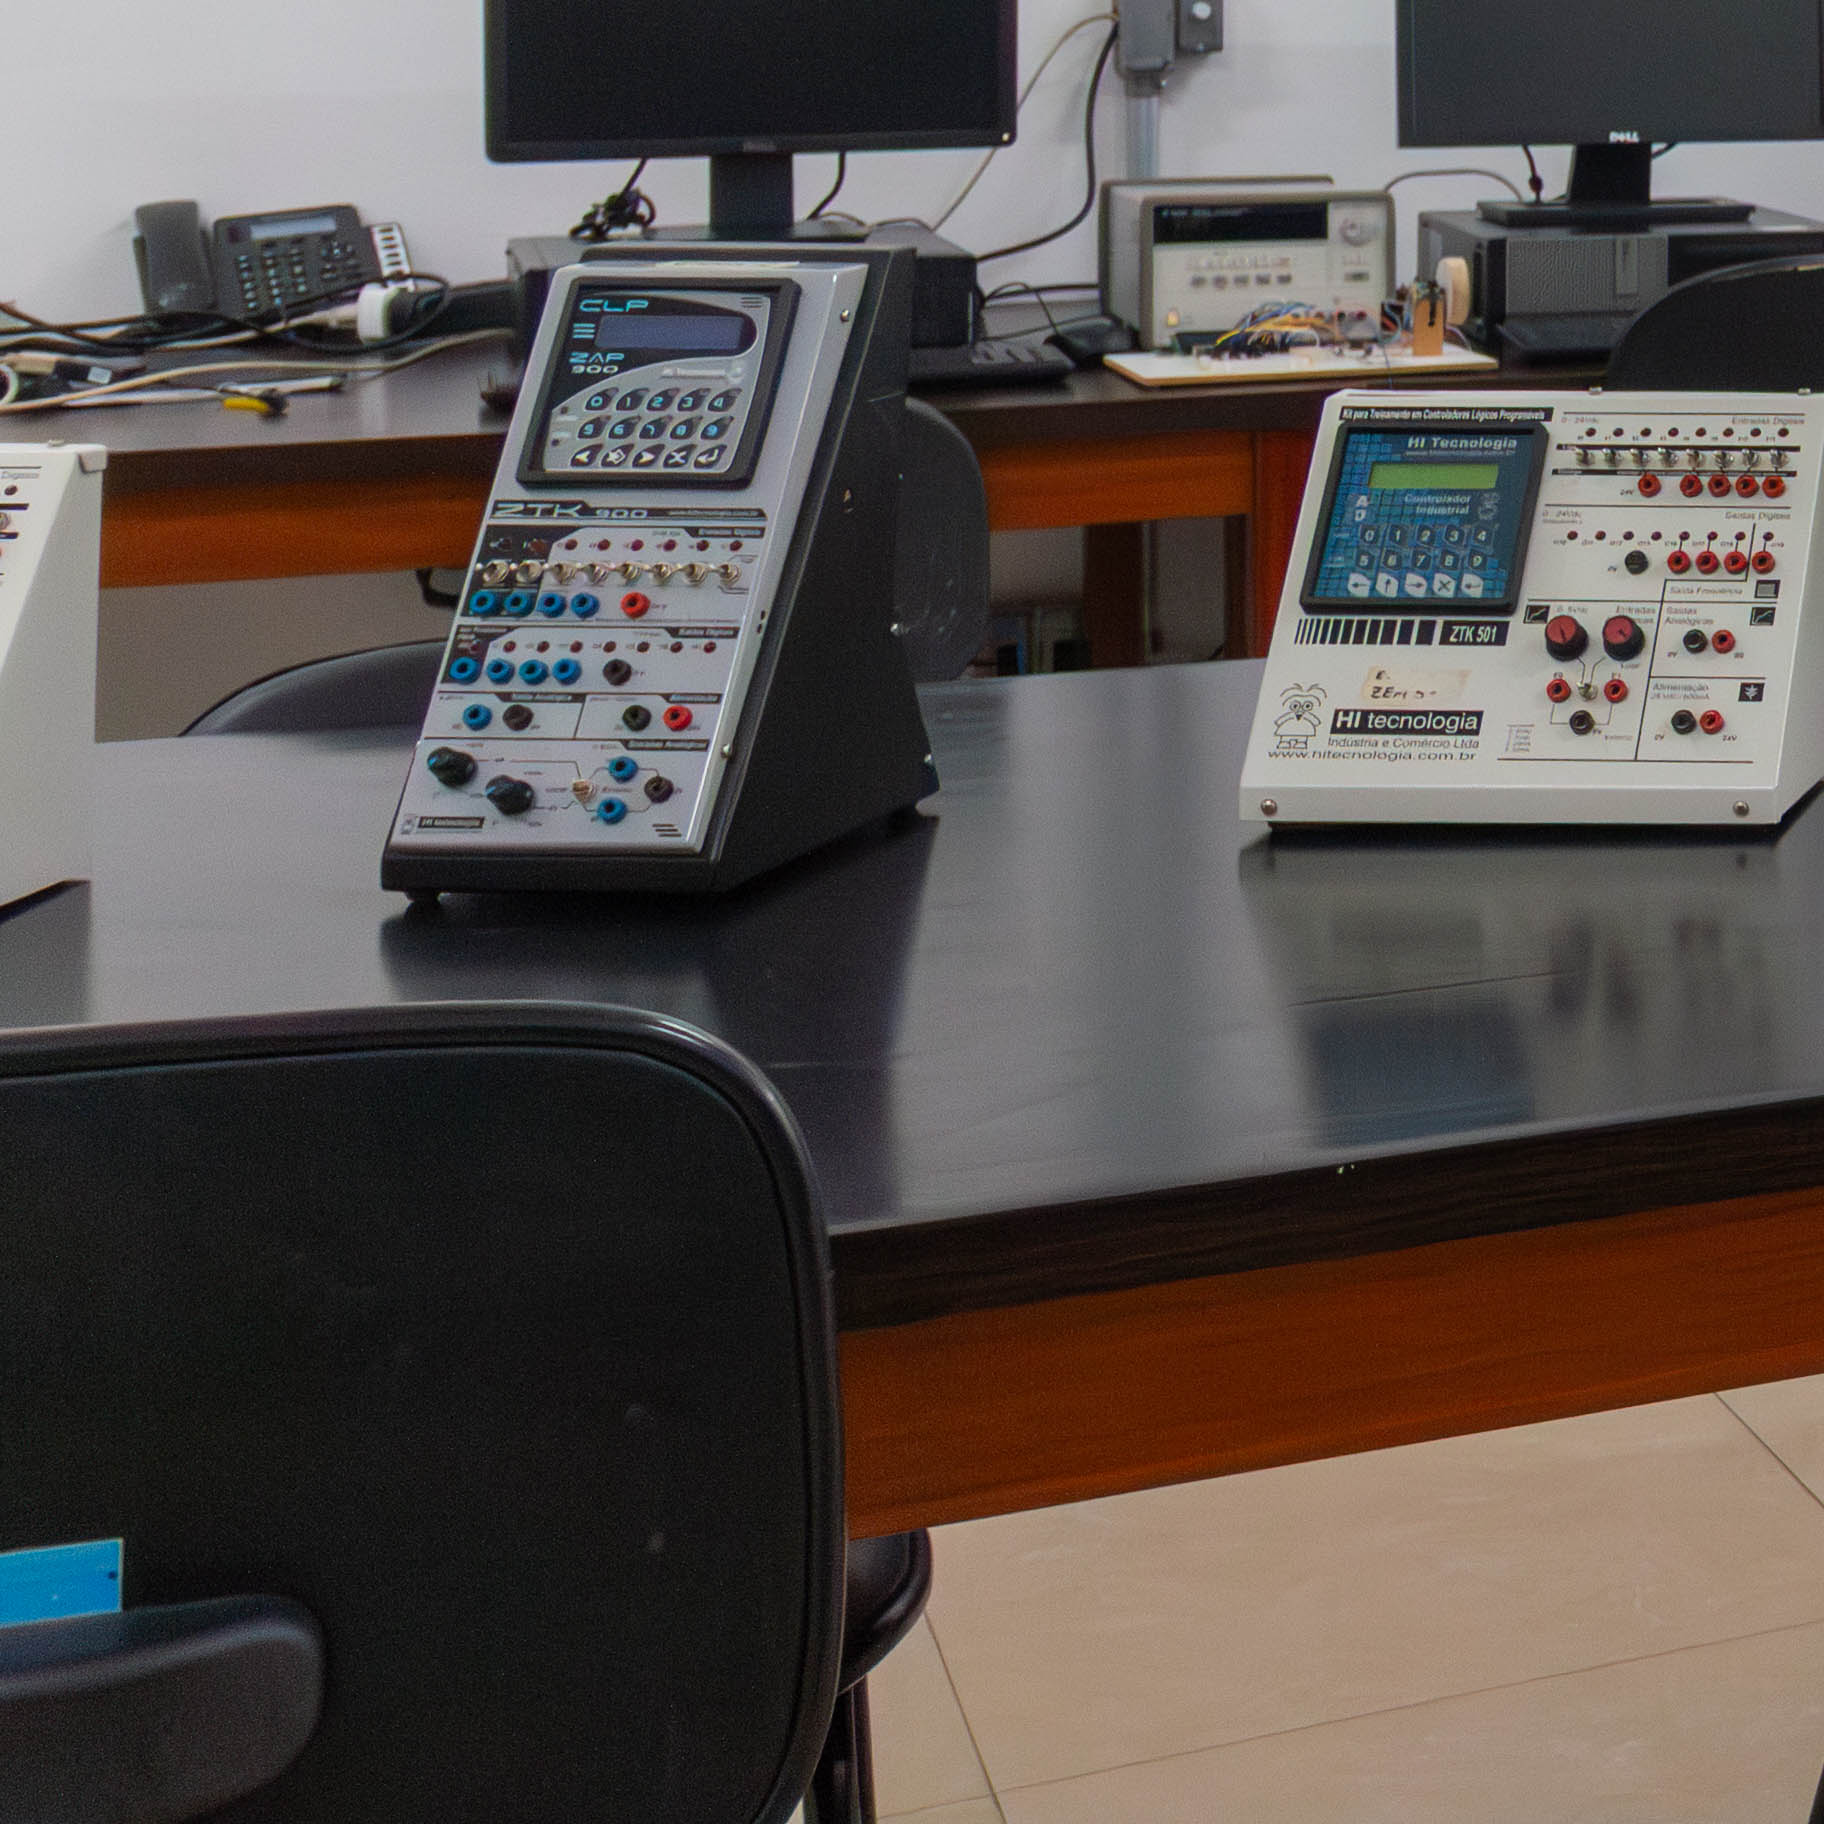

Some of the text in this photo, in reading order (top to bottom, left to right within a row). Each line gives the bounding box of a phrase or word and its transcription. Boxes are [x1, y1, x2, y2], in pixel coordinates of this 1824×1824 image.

[578, 298, 649, 312] CLP
[569, 352, 625, 364] ZAP
[571, 365, 619, 375] 900
[589, 396, 604, 407] 0
[651, 396, 664, 407] 2
[681, 396, 693, 407] 3
[712, 396, 724, 407] 4
[612, 425, 625, 435] 6
[1408, 436, 1518, 450] HI Tecnologia
[494, 503, 648, 519] ZTK 900
[1449, 626, 1498, 643] ZTK 501
[1337, 711, 1478, 733] HI tecnologia
